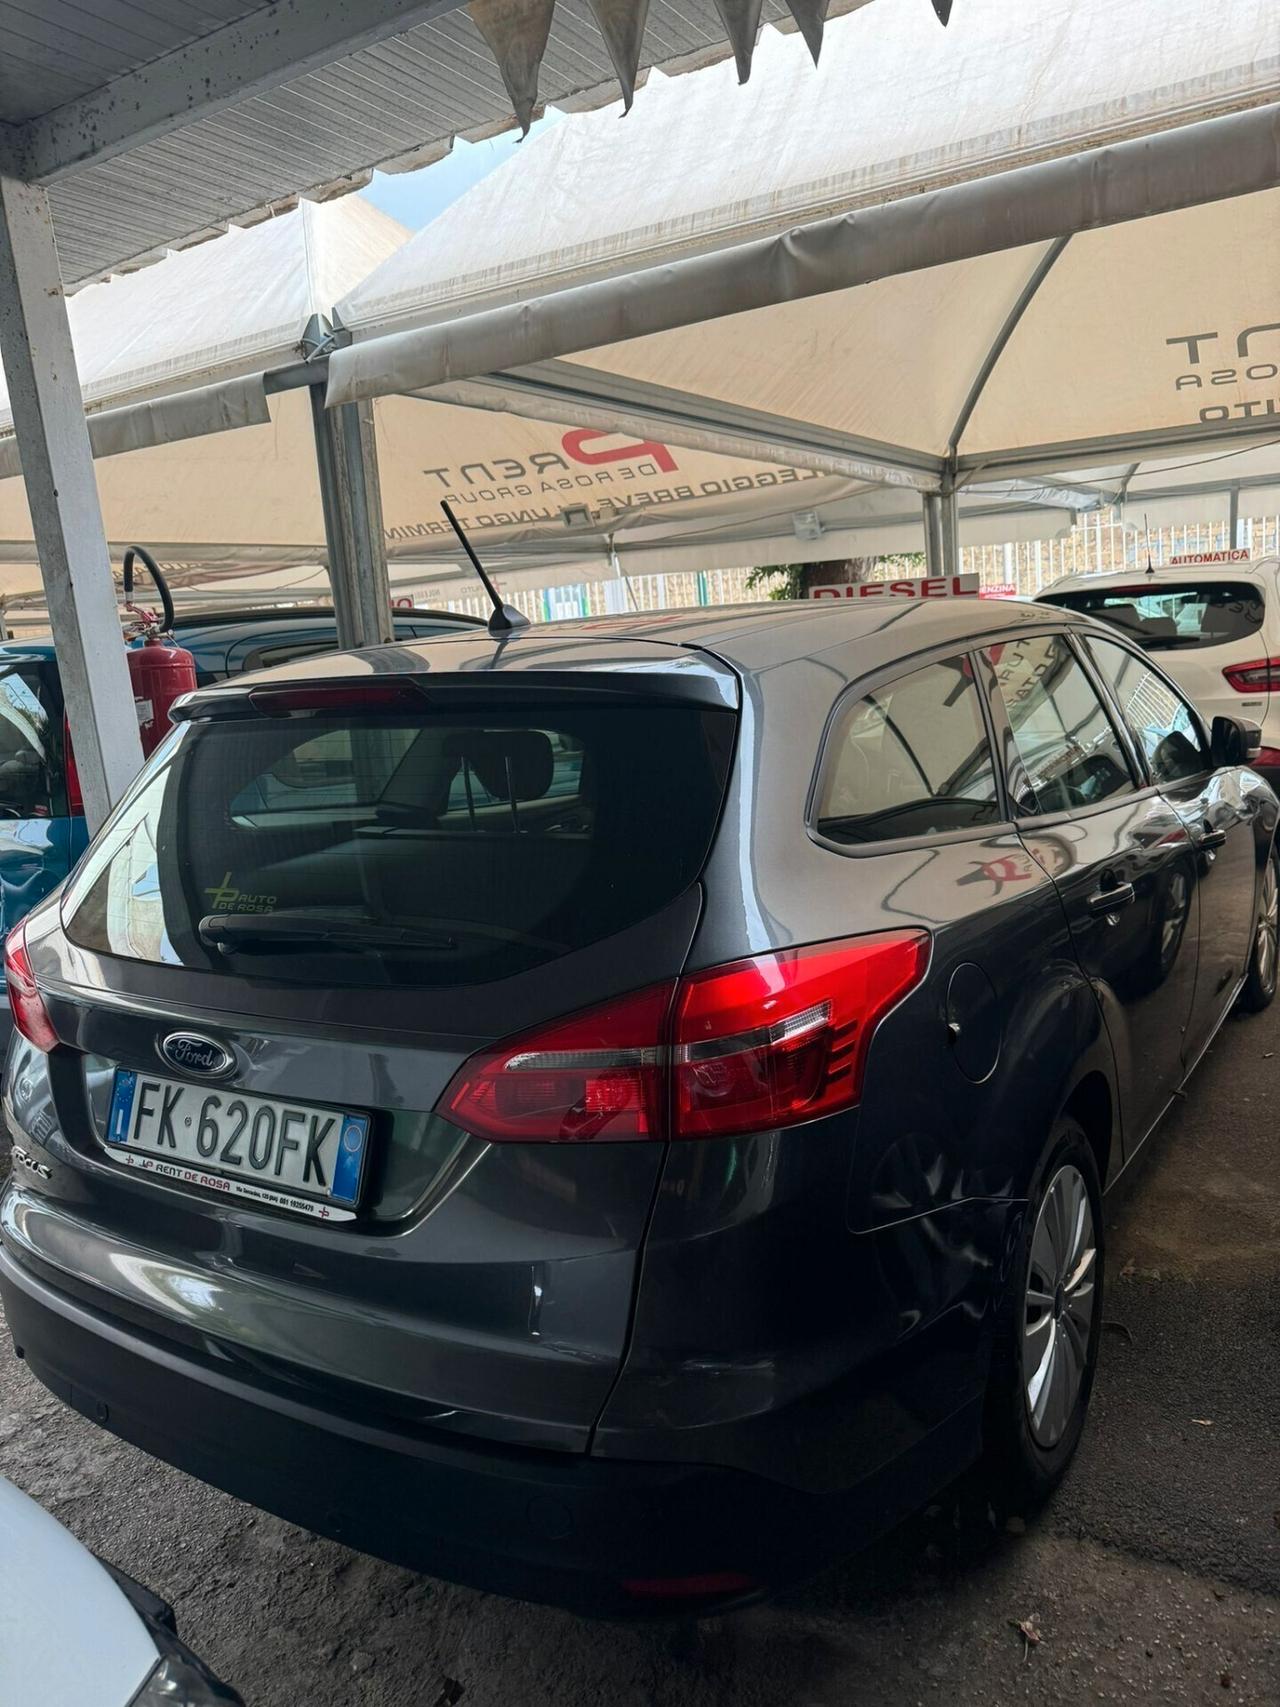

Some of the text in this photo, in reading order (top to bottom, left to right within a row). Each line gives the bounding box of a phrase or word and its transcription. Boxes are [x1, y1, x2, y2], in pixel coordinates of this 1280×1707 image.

[1172, 550, 1250, 565] AUTOMATICA
[813, 576, 977, 600] DIESEL
[980, 584, 1016, 594] ENZINA
[238, 893, 277, 904] AUTO
[218, 902, 274, 913] DE ROSA
[173, 1039, 216, 1067] Ford
[155, 1164, 183, 1177] RENT
[184, 1171, 198, 1182] DE
[200, 1176, 231, 1191] ROSA
